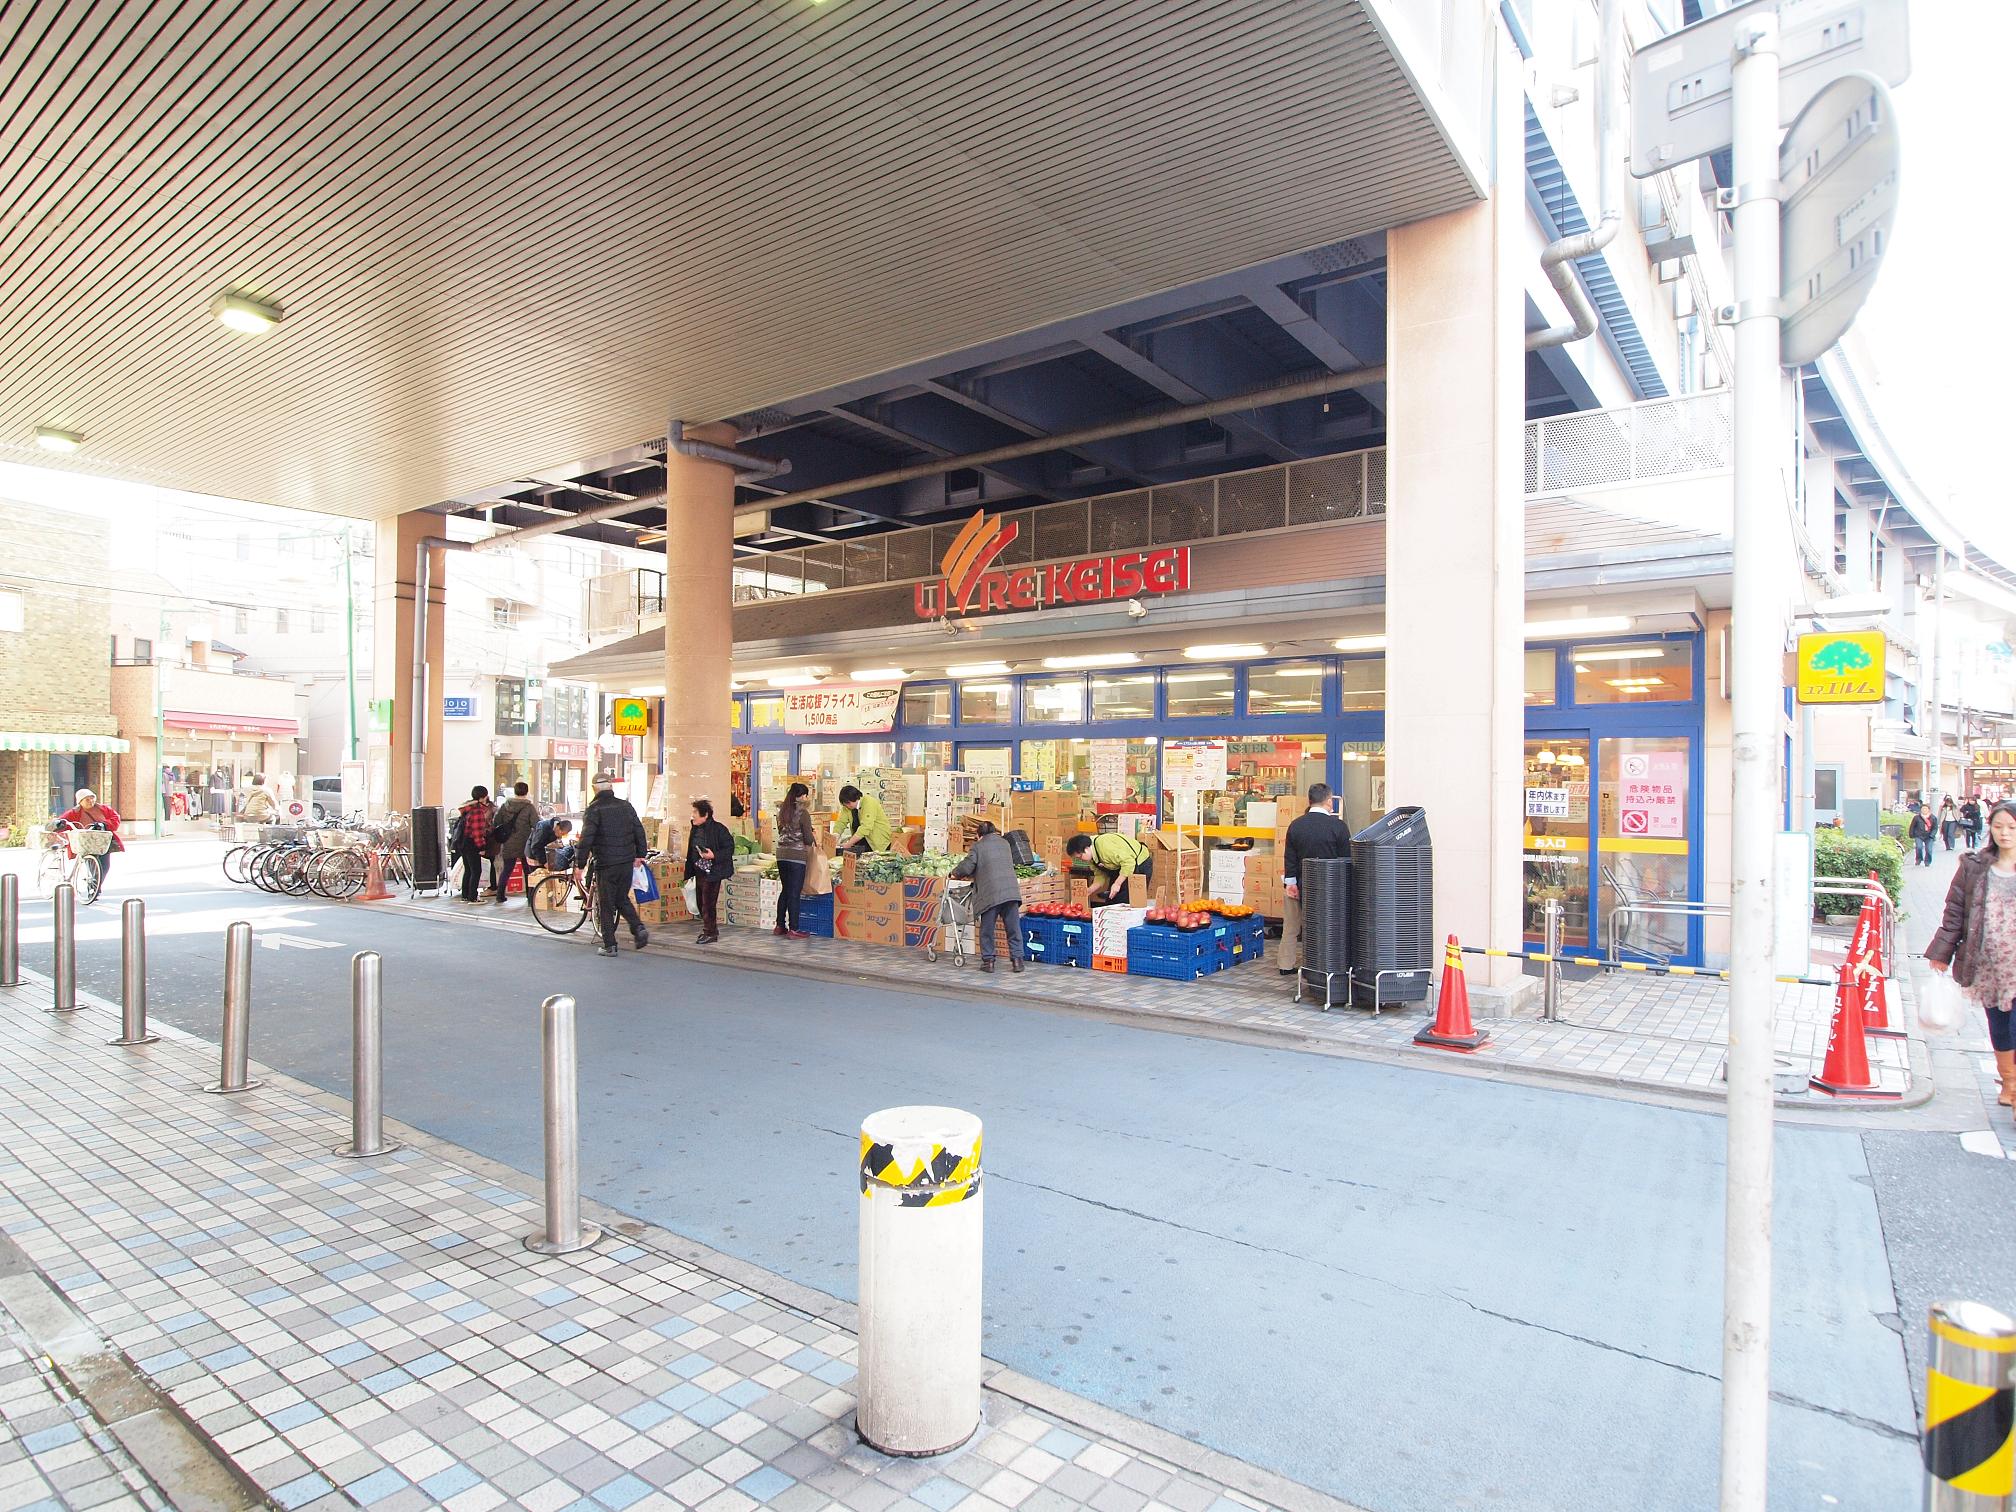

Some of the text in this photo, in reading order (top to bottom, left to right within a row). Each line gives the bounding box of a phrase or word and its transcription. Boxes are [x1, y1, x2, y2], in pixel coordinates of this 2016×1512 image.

[1044, 546, 1190, 604] KEISEI
[1140, 760, 1147, 770] 6
[1243, 764, 1250, 774] 7
[1629, 784, 1672, 793] 危険物品
